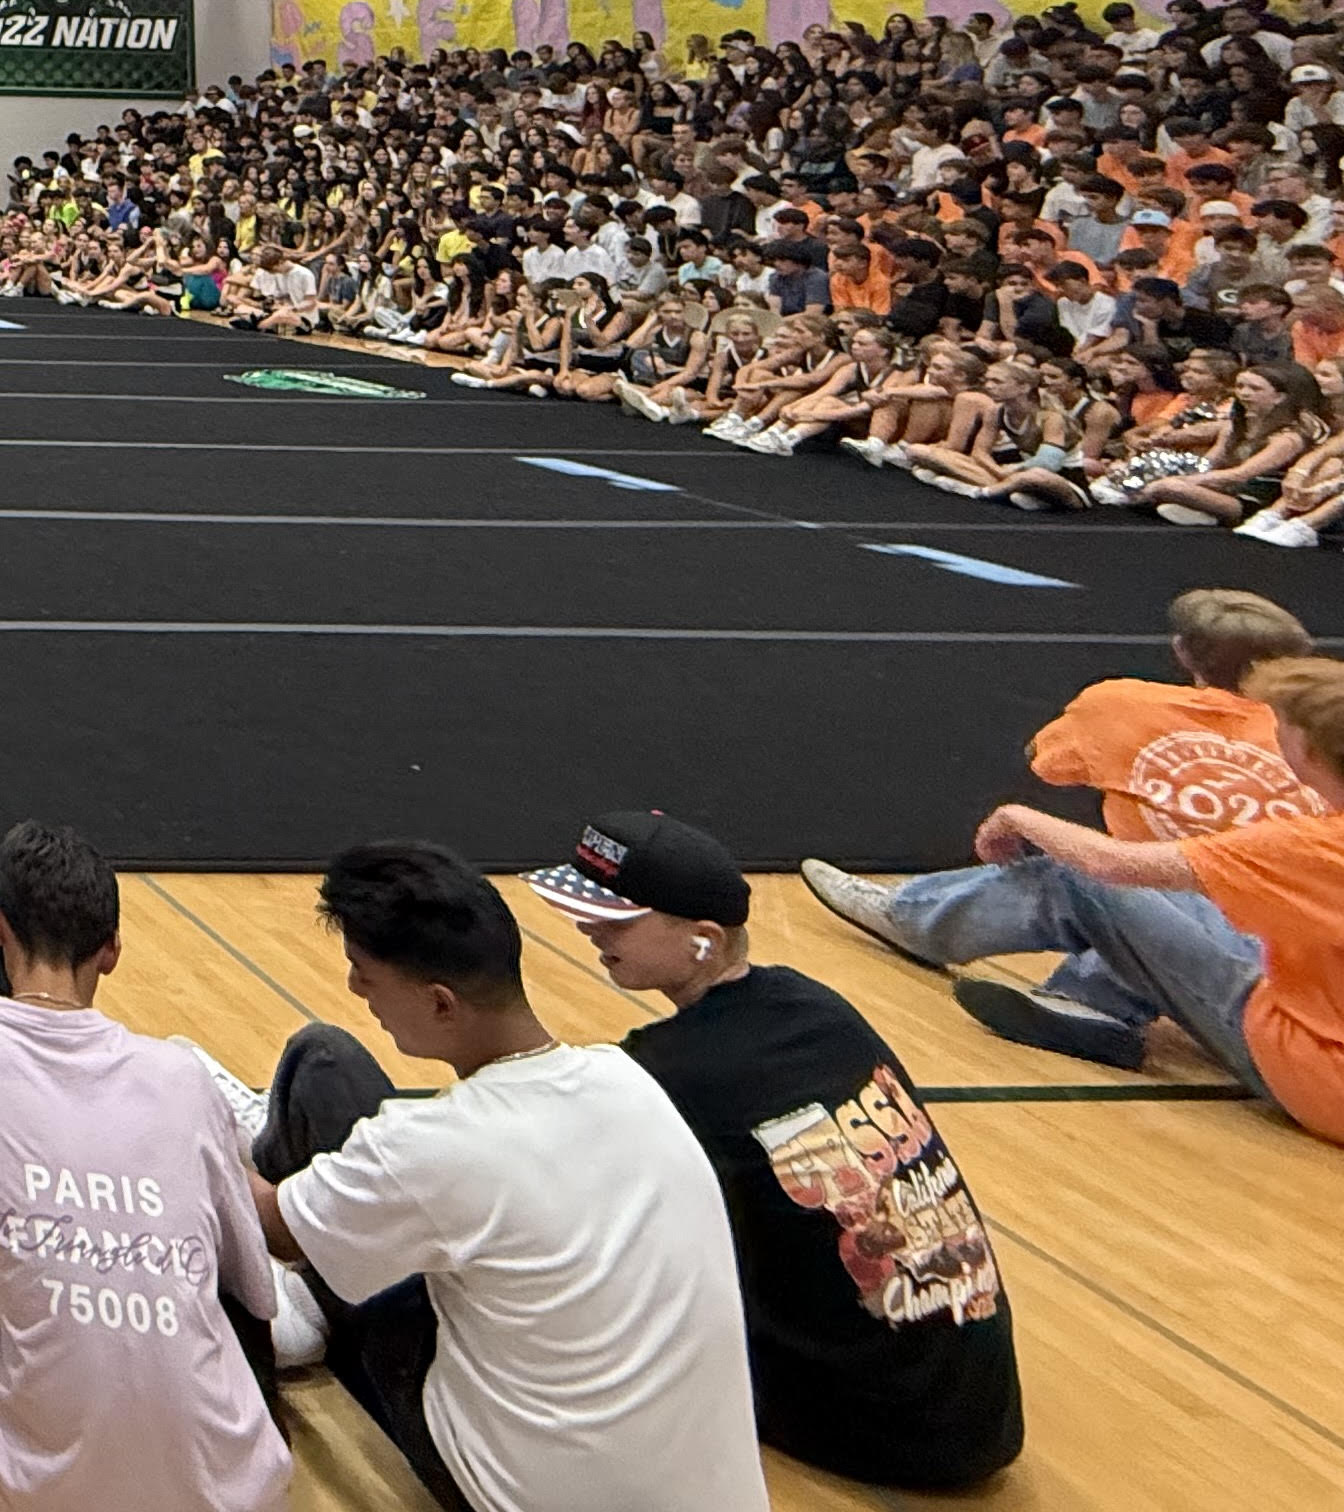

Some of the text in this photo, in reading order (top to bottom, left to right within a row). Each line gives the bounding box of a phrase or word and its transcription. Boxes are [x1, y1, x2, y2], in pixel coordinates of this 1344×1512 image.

[51, 16, 178, 50] NATION
[23, 1163, 165, 1218] PARIS
[42, 1278, 179, 1337] 75008
